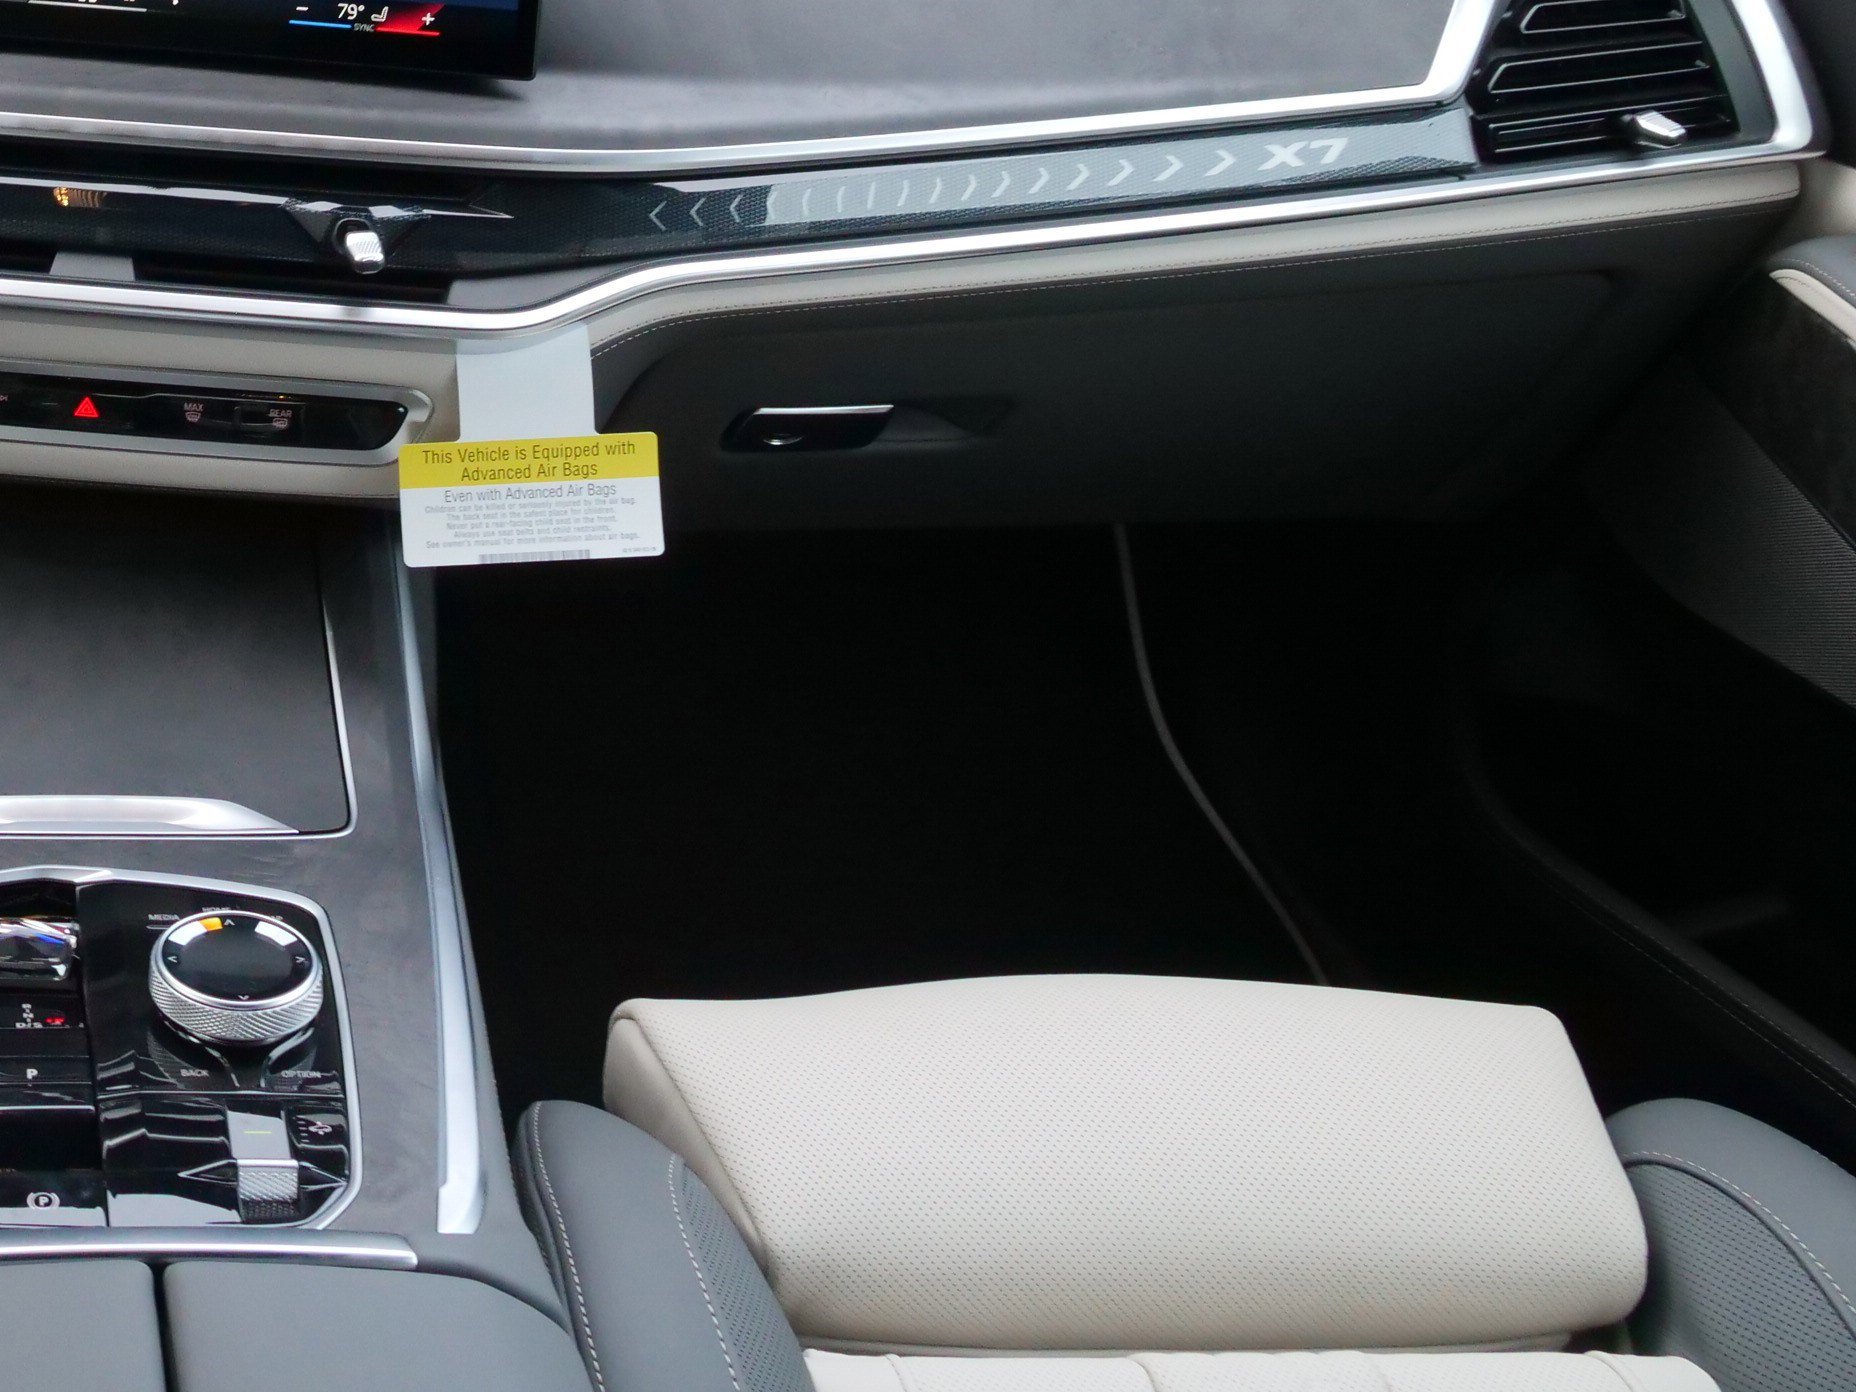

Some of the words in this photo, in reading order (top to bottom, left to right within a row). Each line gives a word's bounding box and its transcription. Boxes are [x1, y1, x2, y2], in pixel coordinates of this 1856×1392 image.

[354, 22, 375, 32] SYNC
[1257, 138, 1348, 171] X7
[184, 402, 204, 411] MAX
[269, 409, 292, 418] REAR
[422, 450, 452, 464] This
[457, 446, 510, 463] Vehicle
[515, 446, 527, 460] is
[532, 442, 599, 461] Equipped
[605, 440, 635, 455] with
[461, 464, 531, 482] Advanced
[537, 463, 557, 477] Air
[562, 461, 598, 479] Bags
[444, 490, 473, 503] Even
[477, 488, 502, 501] with
[506, 485, 563, 500] Advanced
[567, 484, 583, 496] Air
[588, 483, 617, 497] Bags
[425, 505, 456, 513] Children
[519, 501, 551, 509] seriously
[594, 498, 606, 506] the
[548, 509, 568, 517] place
[426, 541, 440, 549] See
[539, 535, 582, 543] information
[584, 533, 605, 541] about
[148, 913, 180, 921] MEDIA
[26, 1068, 38, 1079] P
[180, 1068, 209, 1077] BACK
[280, 1070, 321, 1078] OPTION
